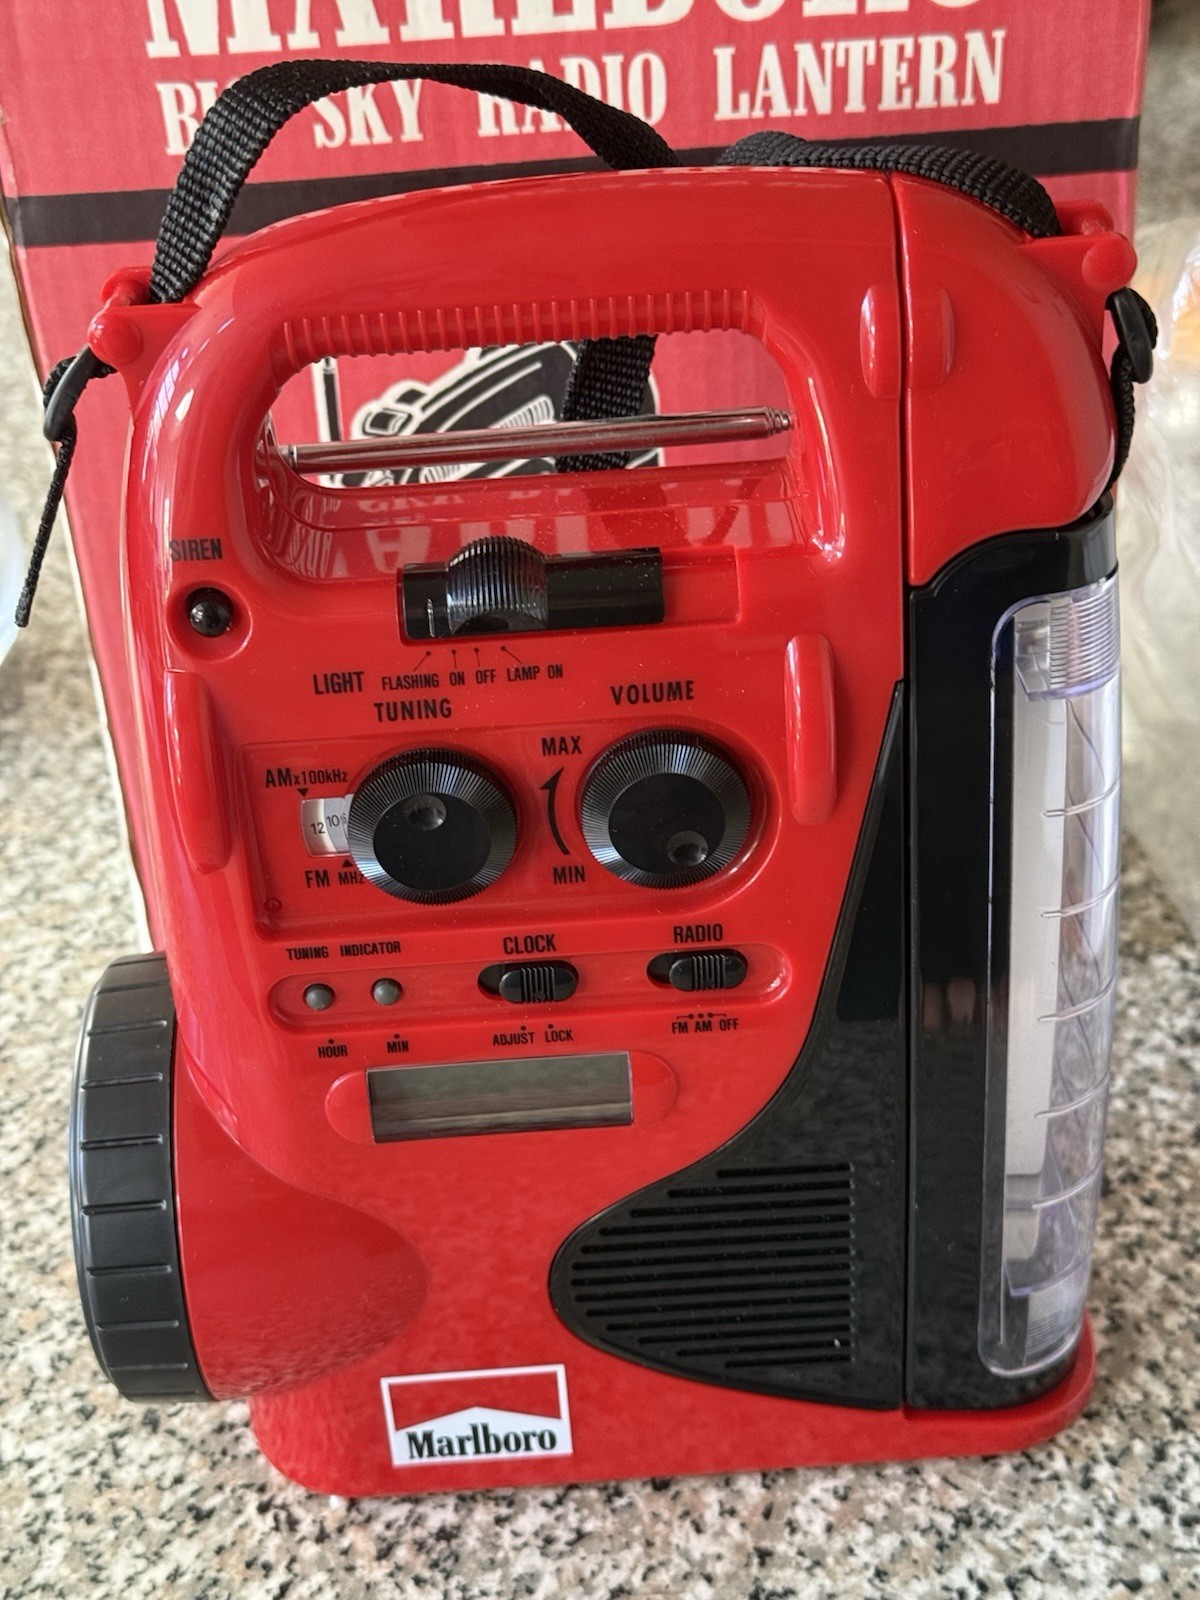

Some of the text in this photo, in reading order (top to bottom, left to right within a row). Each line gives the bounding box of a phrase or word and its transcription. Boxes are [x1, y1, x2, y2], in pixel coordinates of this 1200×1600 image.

[712, 26, 1007, 121] LANTERN
[169, 538, 222, 561] SIREN
[313, 664, 563, 695] LIGHT FLASHING ON OFF LAMP ON
[611, 680, 694, 705] VOLUME
[374, 698, 452, 722] TUNING
[541, 735, 582, 756] MAX
[310, 821, 325, 835] 12
[326, 814, 340, 827] 10
[305, 869, 331, 888] FM
[553, 865, 586, 885] MIN
[673, 923, 723, 943] RADIO
[285, 941, 402, 960] TUNING INDICATOR
[503, 934, 557, 955] CLOCK
[672, 1018, 739, 1034] FM AM OFF
[387, 1041, 409, 1053] MIN
[492, 1029, 574, 1046] ADJUST LOCK
[317, 1045, 348, 1058] HOUR
[405, 1422, 557, 1459] Marlboro
